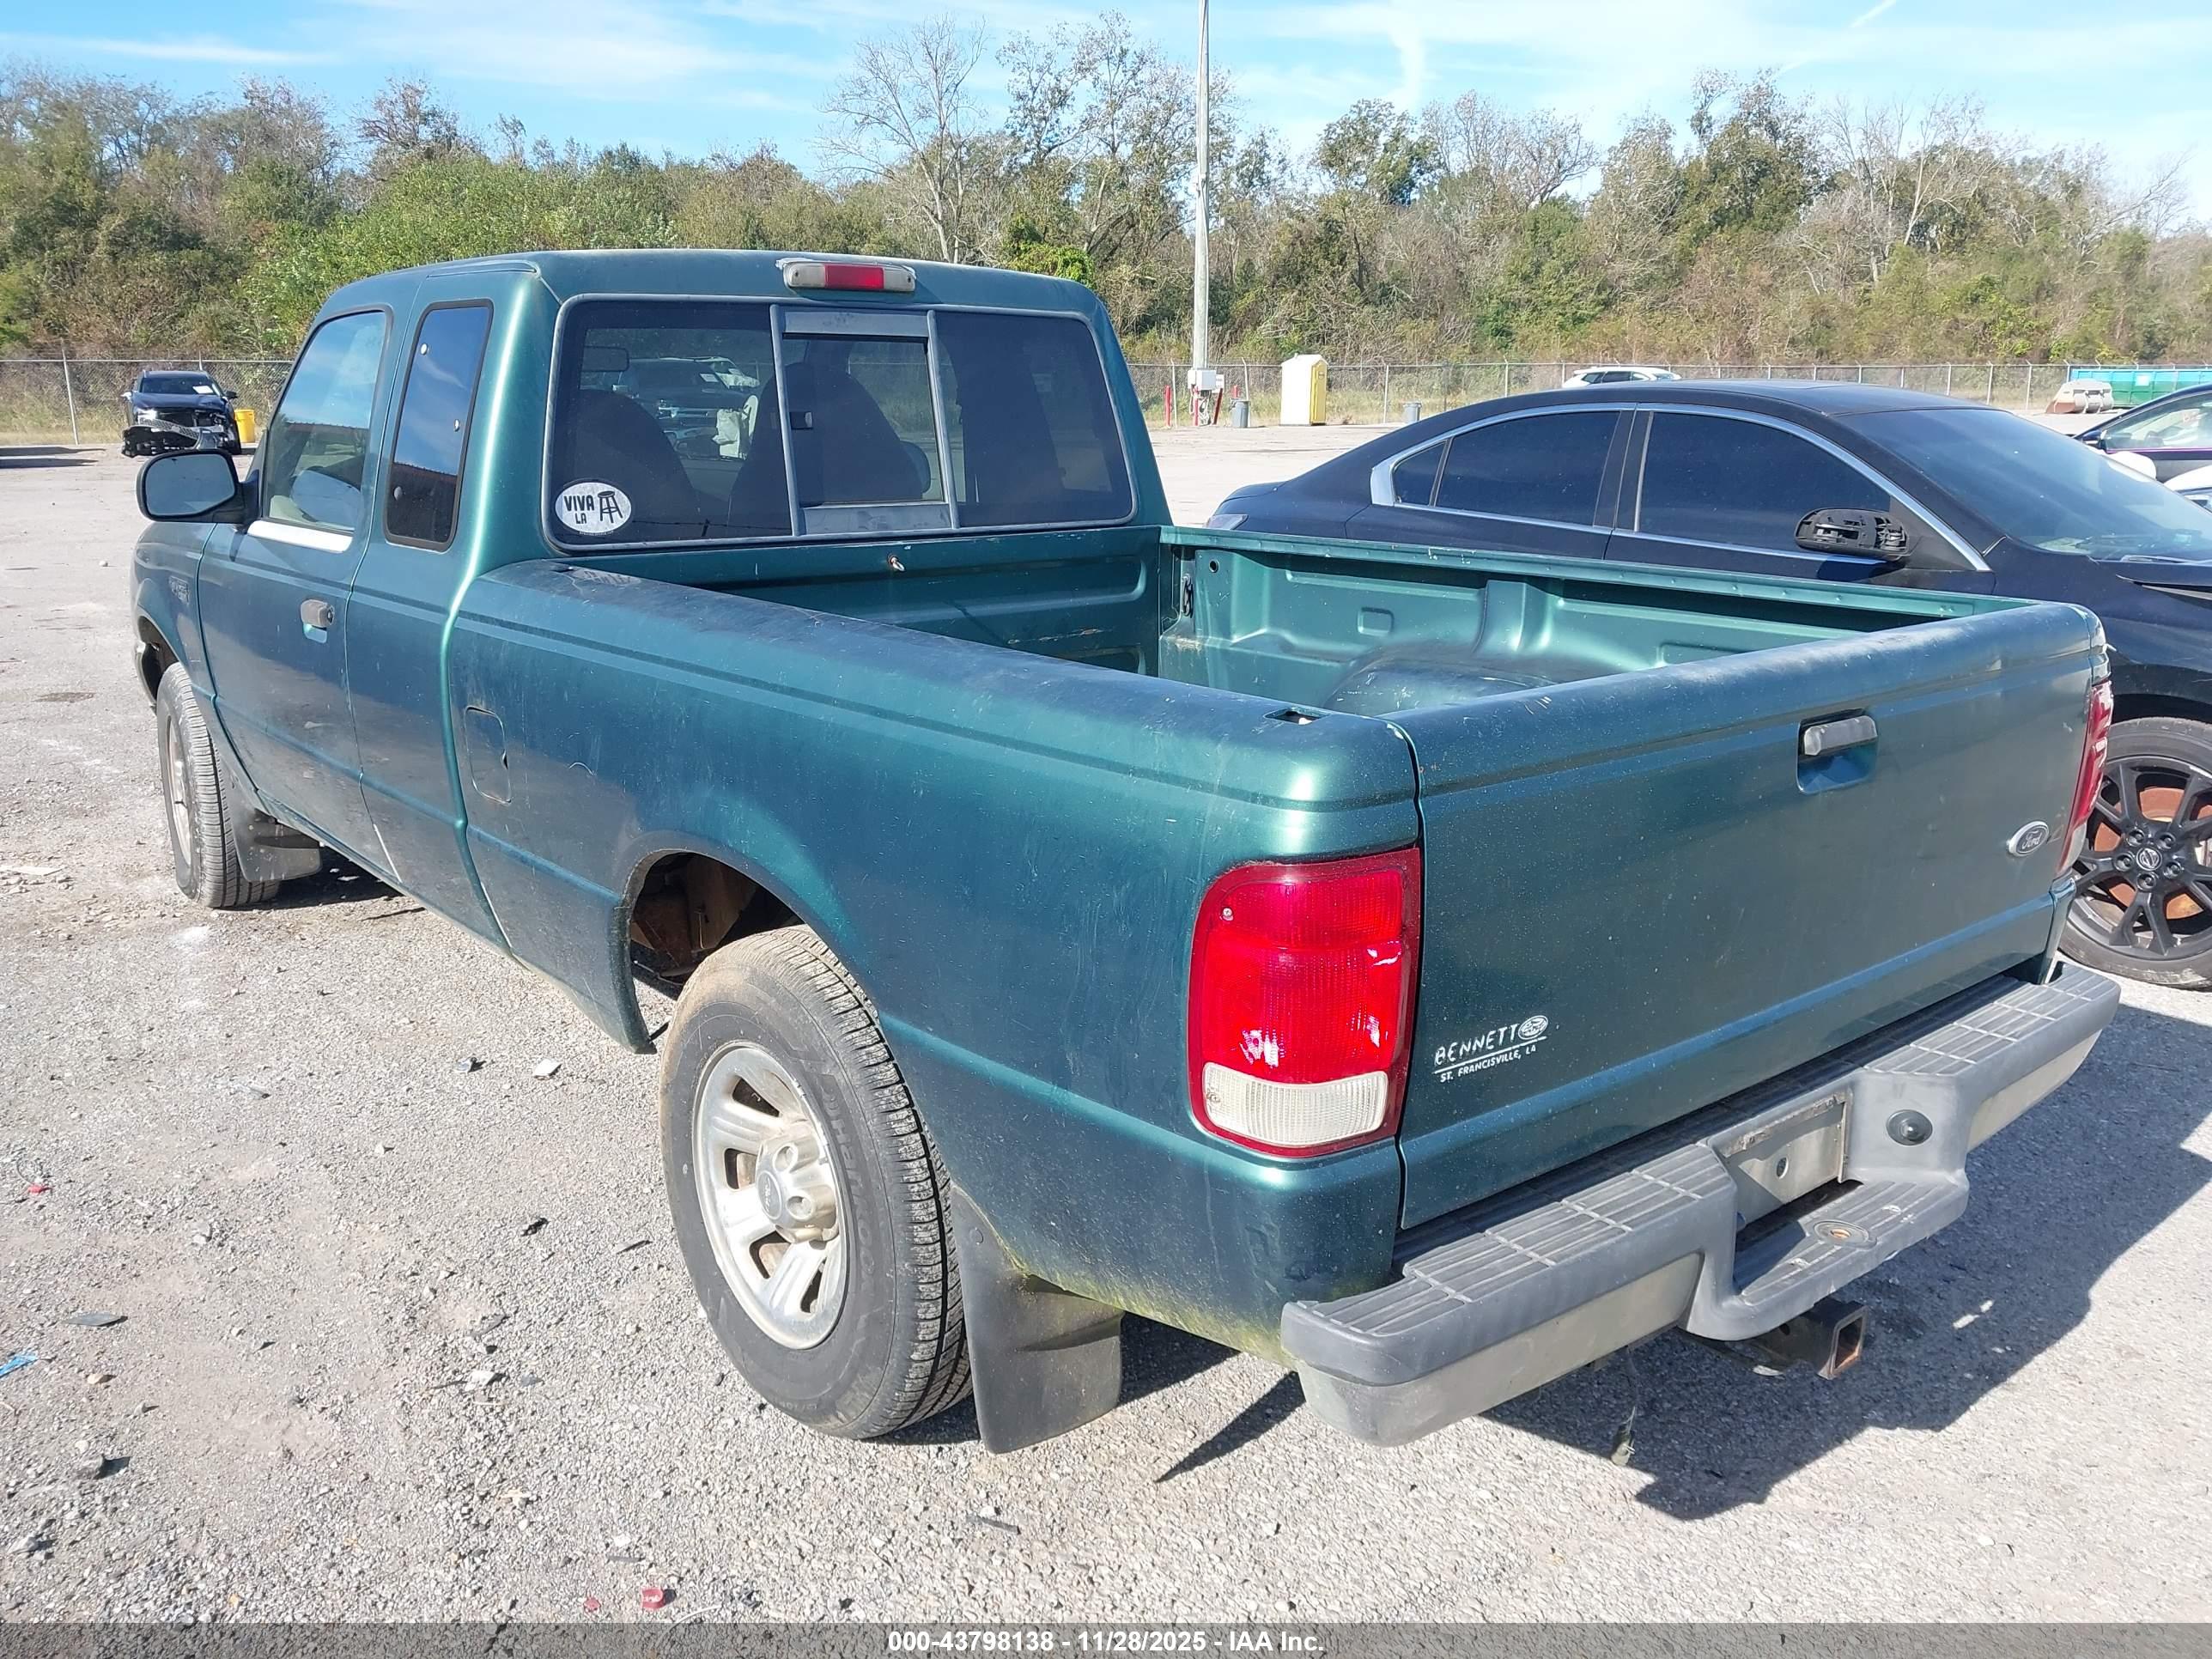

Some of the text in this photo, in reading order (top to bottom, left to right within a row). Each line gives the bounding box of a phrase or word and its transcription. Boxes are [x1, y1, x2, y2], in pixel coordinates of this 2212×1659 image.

[563, 495, 595, 512] VIVA
[574, 513, 587, 524] LA
[1434, 1024, 1520, 1066] BENNETT
[1439, 1044, 1537, 1083] ST. FRANCISVILLE, LA
